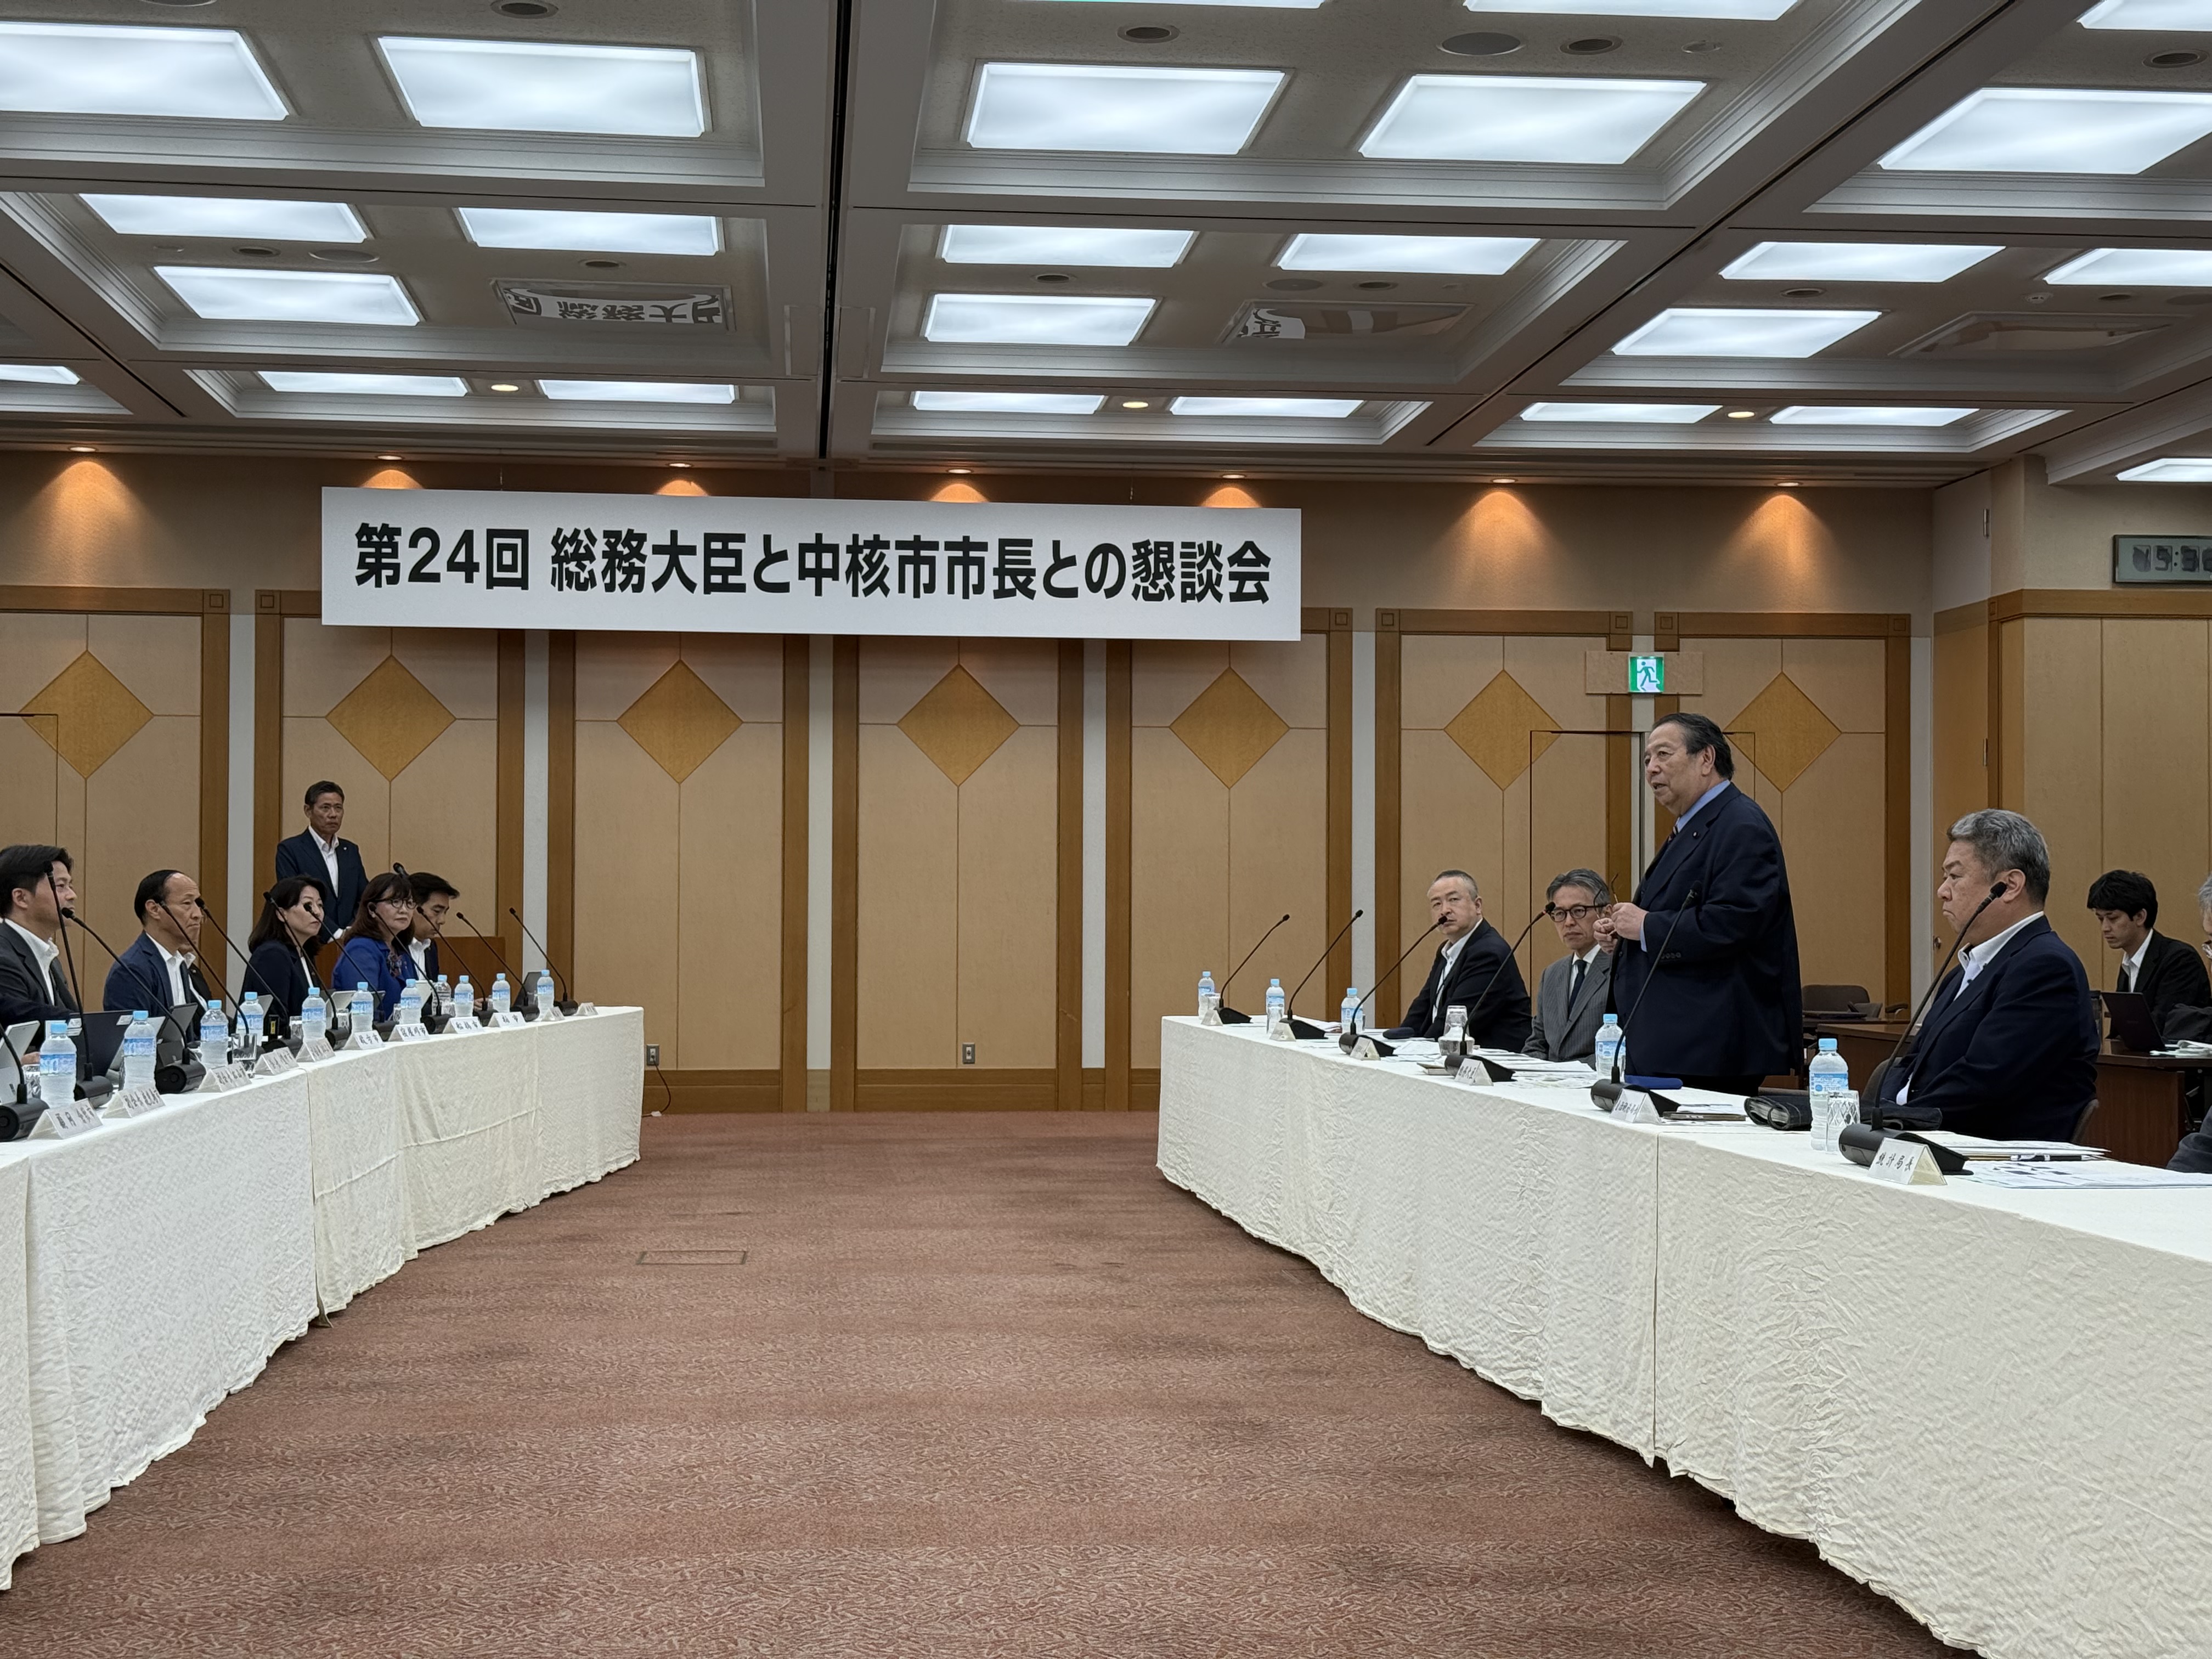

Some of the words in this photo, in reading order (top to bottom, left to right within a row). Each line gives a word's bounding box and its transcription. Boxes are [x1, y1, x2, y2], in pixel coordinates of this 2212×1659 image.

[354, 522, 530, 591] 第24回
[550, 527, 1272, 605] 総務大臣と中核市市長との懇談会
